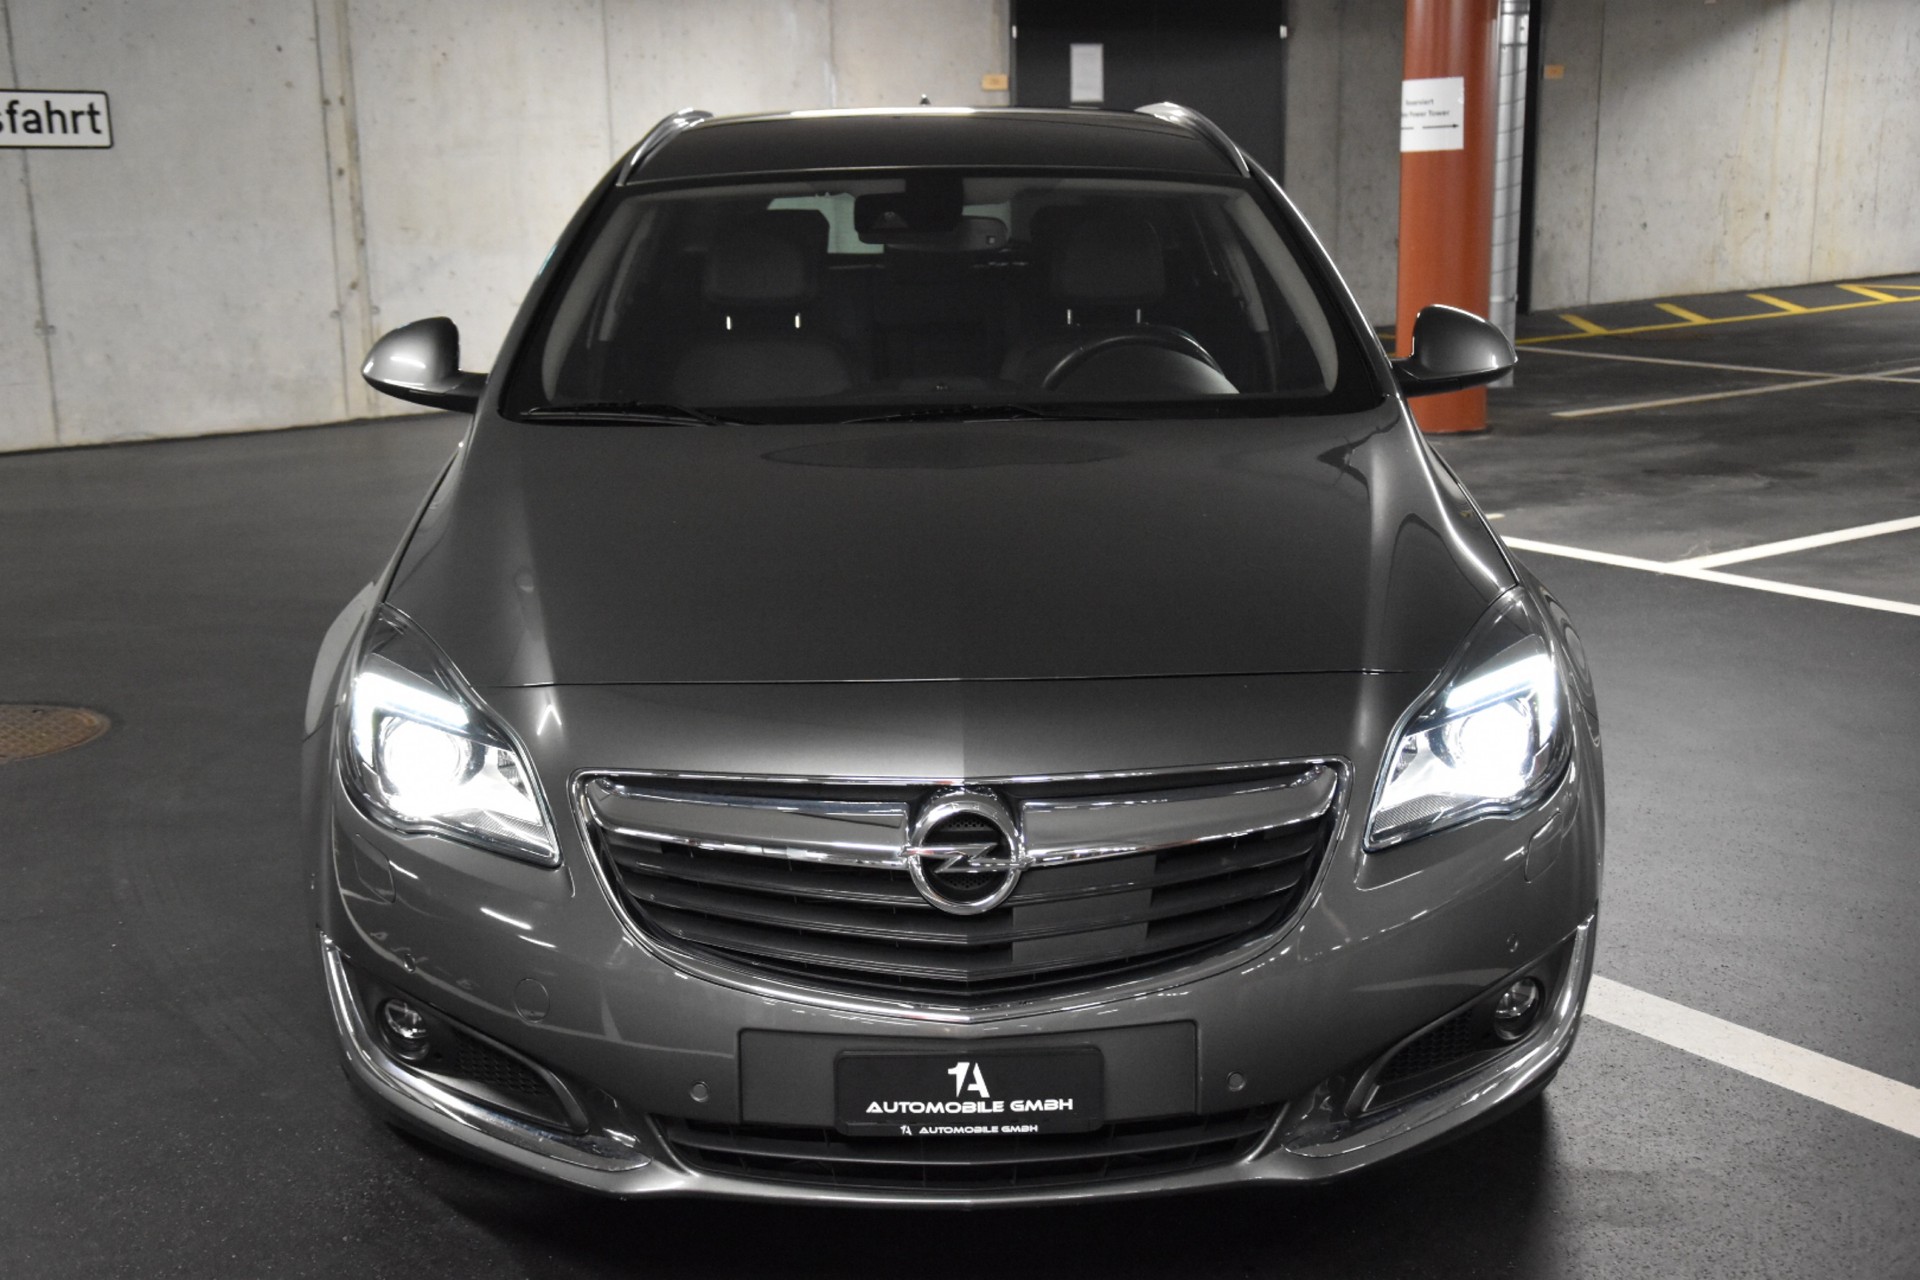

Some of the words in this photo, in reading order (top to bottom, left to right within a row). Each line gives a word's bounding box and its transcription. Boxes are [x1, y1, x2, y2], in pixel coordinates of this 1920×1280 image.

[0, 99, 102, 134] fahrt
[948, 1061, 990, 1098] 1A
[866, 1101, 1005, 1113] AUTOMOBILE
[1010, 1098, 1073, 1112] GMBH
[918, 1126, 998, 1134] AUTOMOBILE
[1001, 1124, 1038, 1133] GMBH
